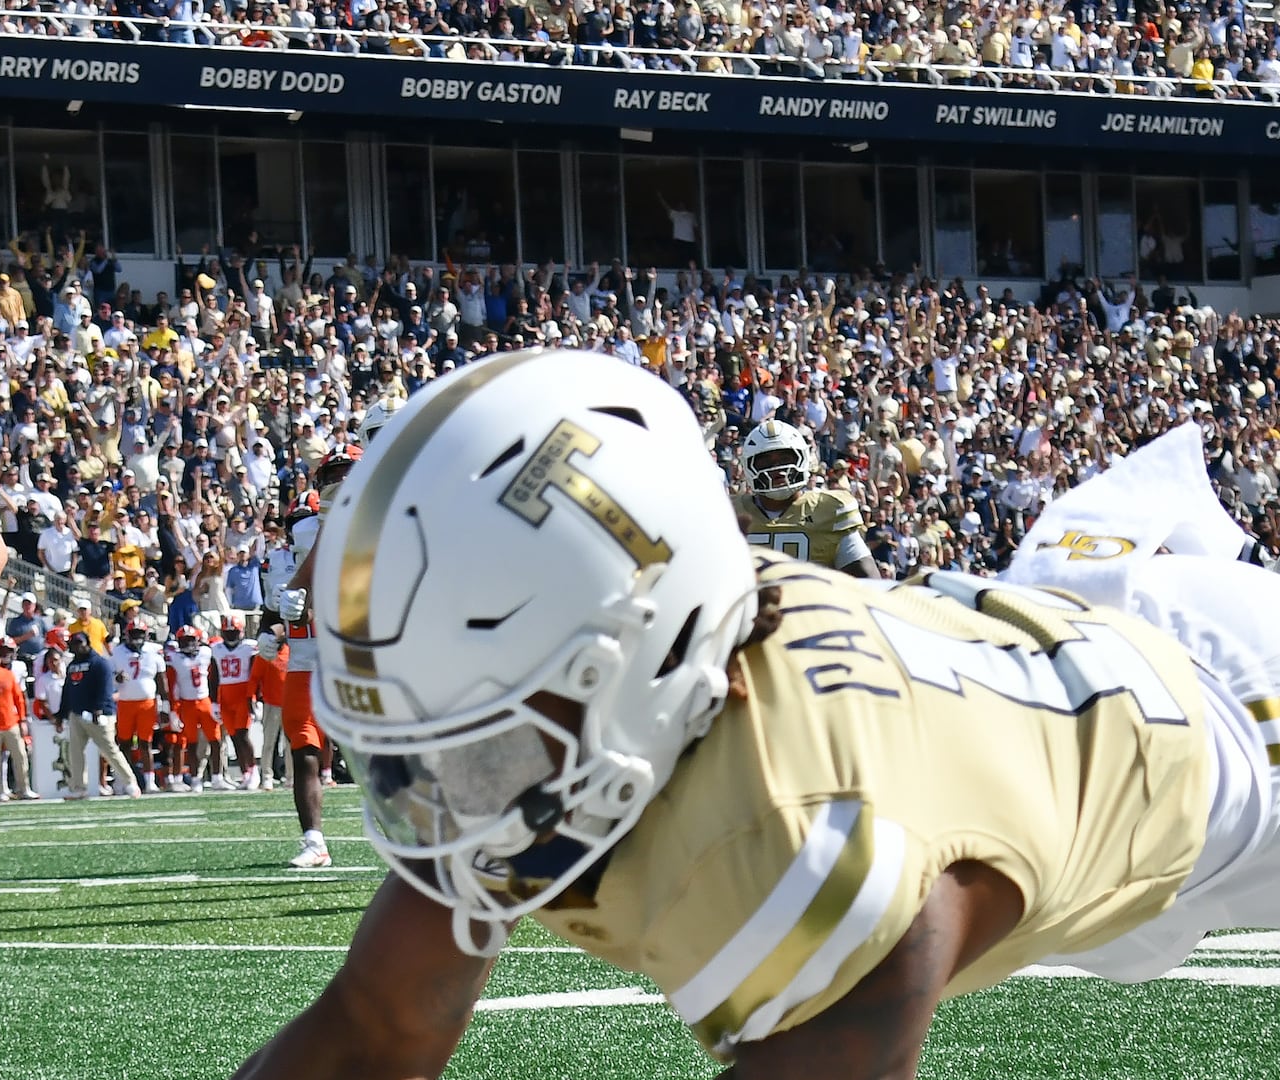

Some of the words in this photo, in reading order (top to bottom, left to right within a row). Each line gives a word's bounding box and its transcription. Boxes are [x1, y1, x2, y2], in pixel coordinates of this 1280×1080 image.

[51, 59, 140, 83] MORRIS
[200, 66, 276, 90] BOBBY
[281, 71, 345, 94] DODD
[401, 77, 473, 99] BOBBY
[478, 81, 562, 105] GASTON
[614, 88, 657, 110] RAY
[659, 91, 710, 112] BECK
[759, 96, 826, 118] RANDY
[829, 99, 889, 121] RHINO
[936, 104, 971, 125] PAT
[972, 106, 1057, 129] SWILLING
[1101, 112, 1136, 133] JOE
[1138, 115, 1224, 136] HAMILTON
[333, 679, 386, 716] TECH
